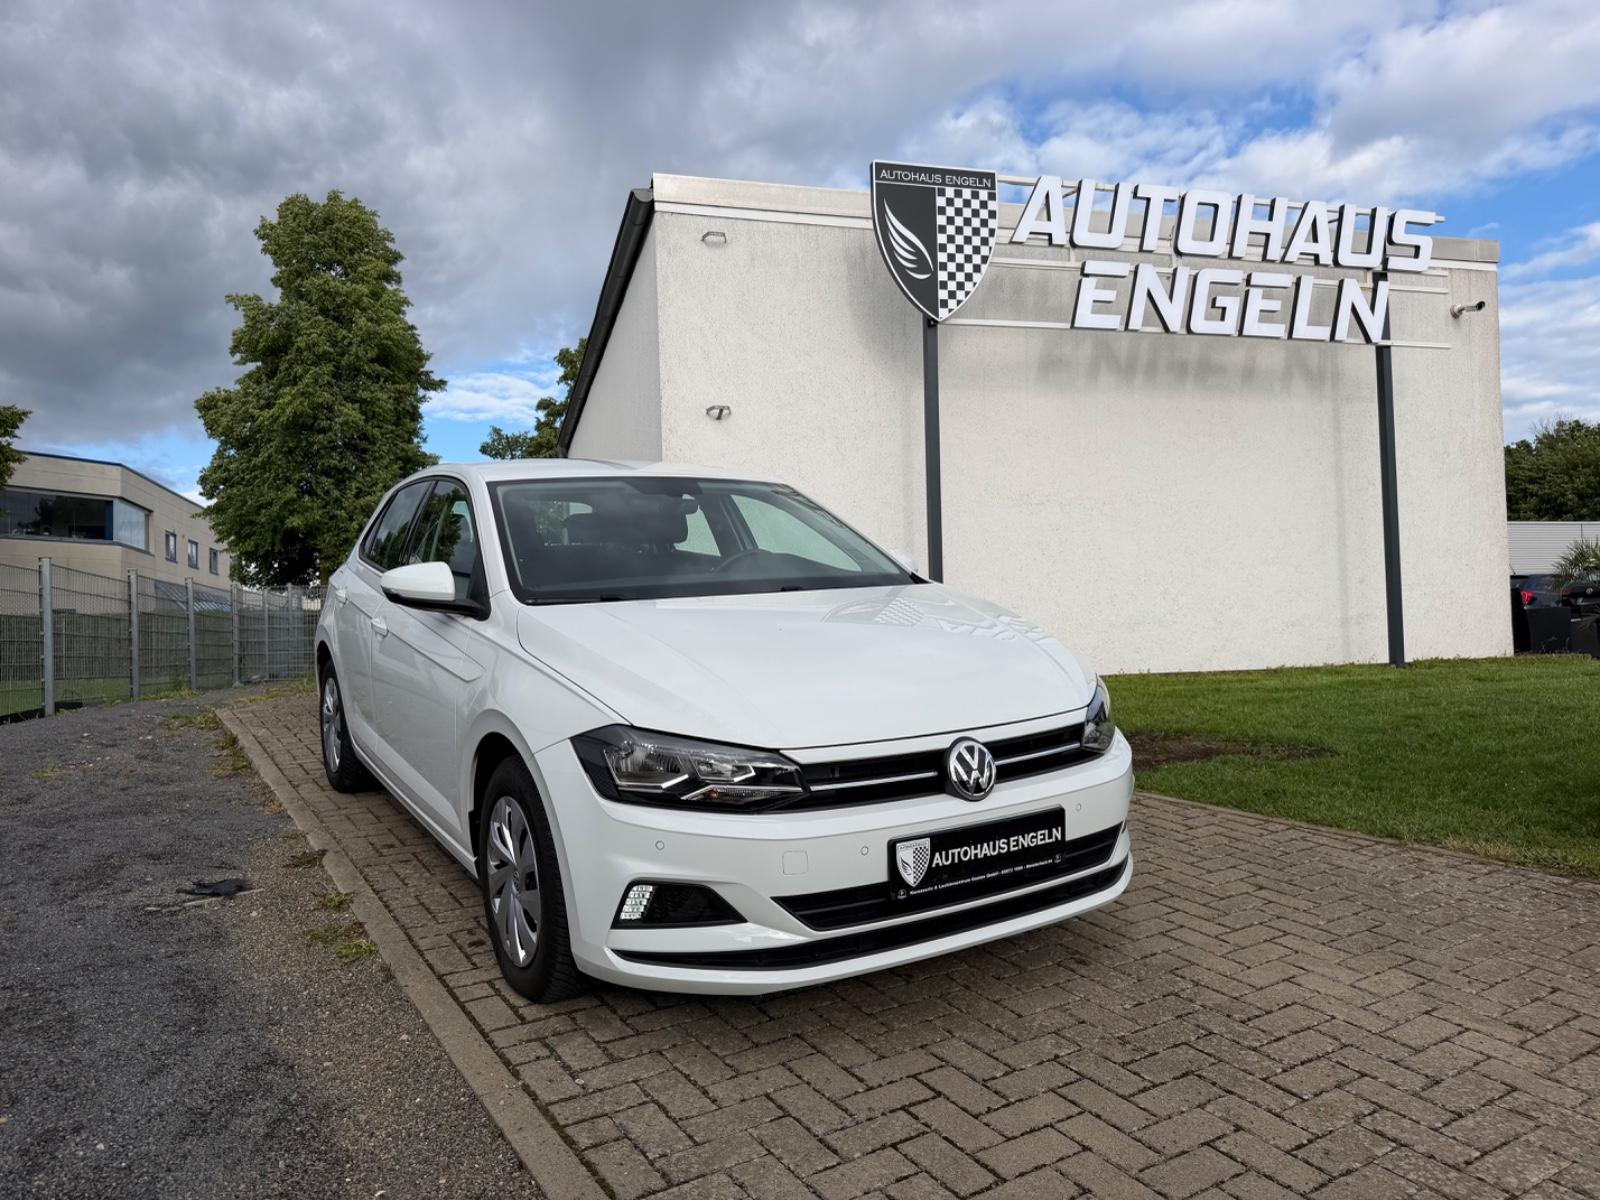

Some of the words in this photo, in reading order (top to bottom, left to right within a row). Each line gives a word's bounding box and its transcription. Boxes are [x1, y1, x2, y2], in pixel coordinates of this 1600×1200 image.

[880, 169, 942, 184] AUTOHAUS
[945, 175, 991, 187] ENGELN
[1010, 175, 1436, 273] AUTOHAUS
[1071, 260, 1390, 344] ENGELN
[949, 740, 995, 797] VW
[931, 838, 1008, 868] AUTOHAUS
[1009, 826, 1062, 852] ENGELN
